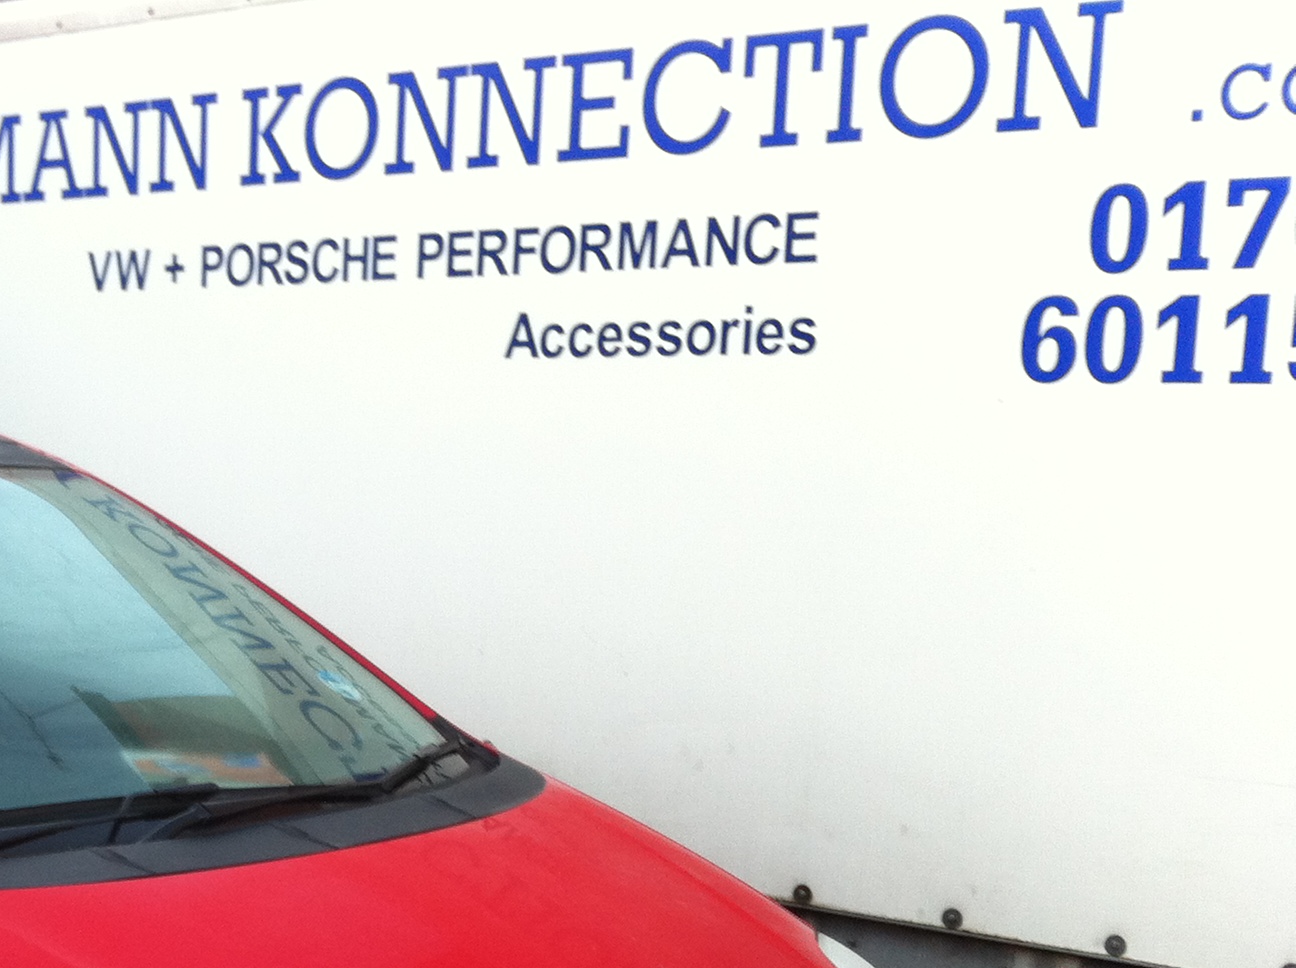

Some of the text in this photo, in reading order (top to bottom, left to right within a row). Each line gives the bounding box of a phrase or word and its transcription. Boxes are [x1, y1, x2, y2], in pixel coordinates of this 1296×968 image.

[240, 0, 1125, 186] KONNECTION
[1191, 62, 1296, 122] .c
[89, 211, 819, 291] VW + PORSCHE PERFORMANCE
[1090, 176, 1296, 274] 017
[505, 304, 816, 359] Accessories
[1021, 293, 1296, 385] 6011
